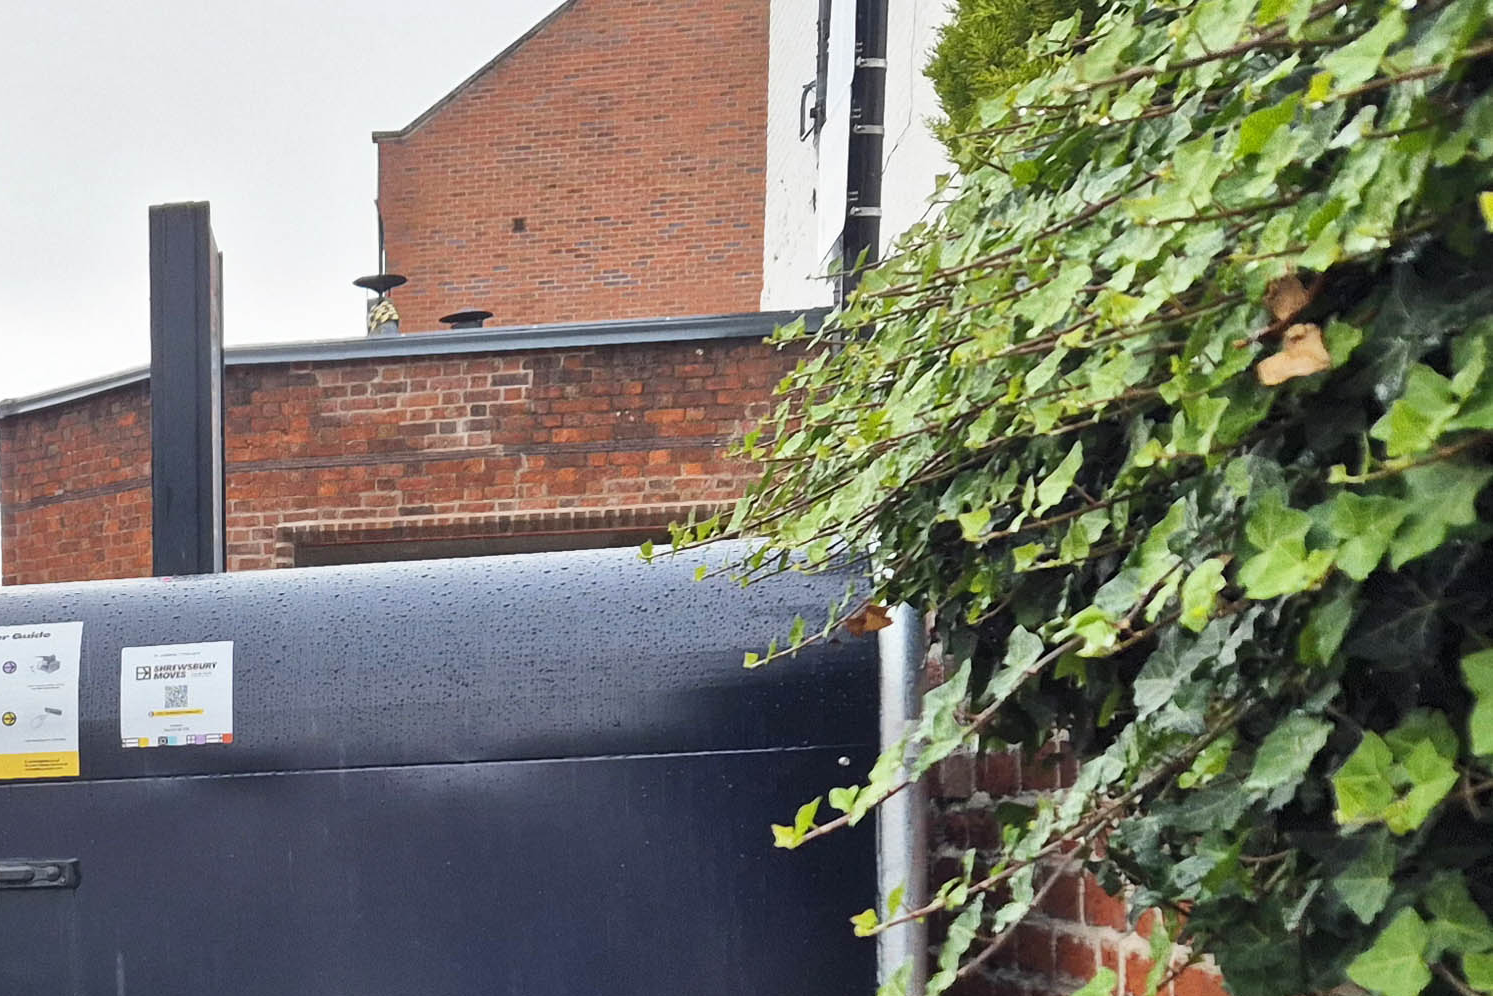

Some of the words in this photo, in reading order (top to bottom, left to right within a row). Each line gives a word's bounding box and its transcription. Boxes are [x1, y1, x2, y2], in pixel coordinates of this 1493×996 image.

[12, 631, 51, 640] Guide
[153, 662, 217, 672] SHREWSBURY
[153, 671, 186, 680] MOVES
